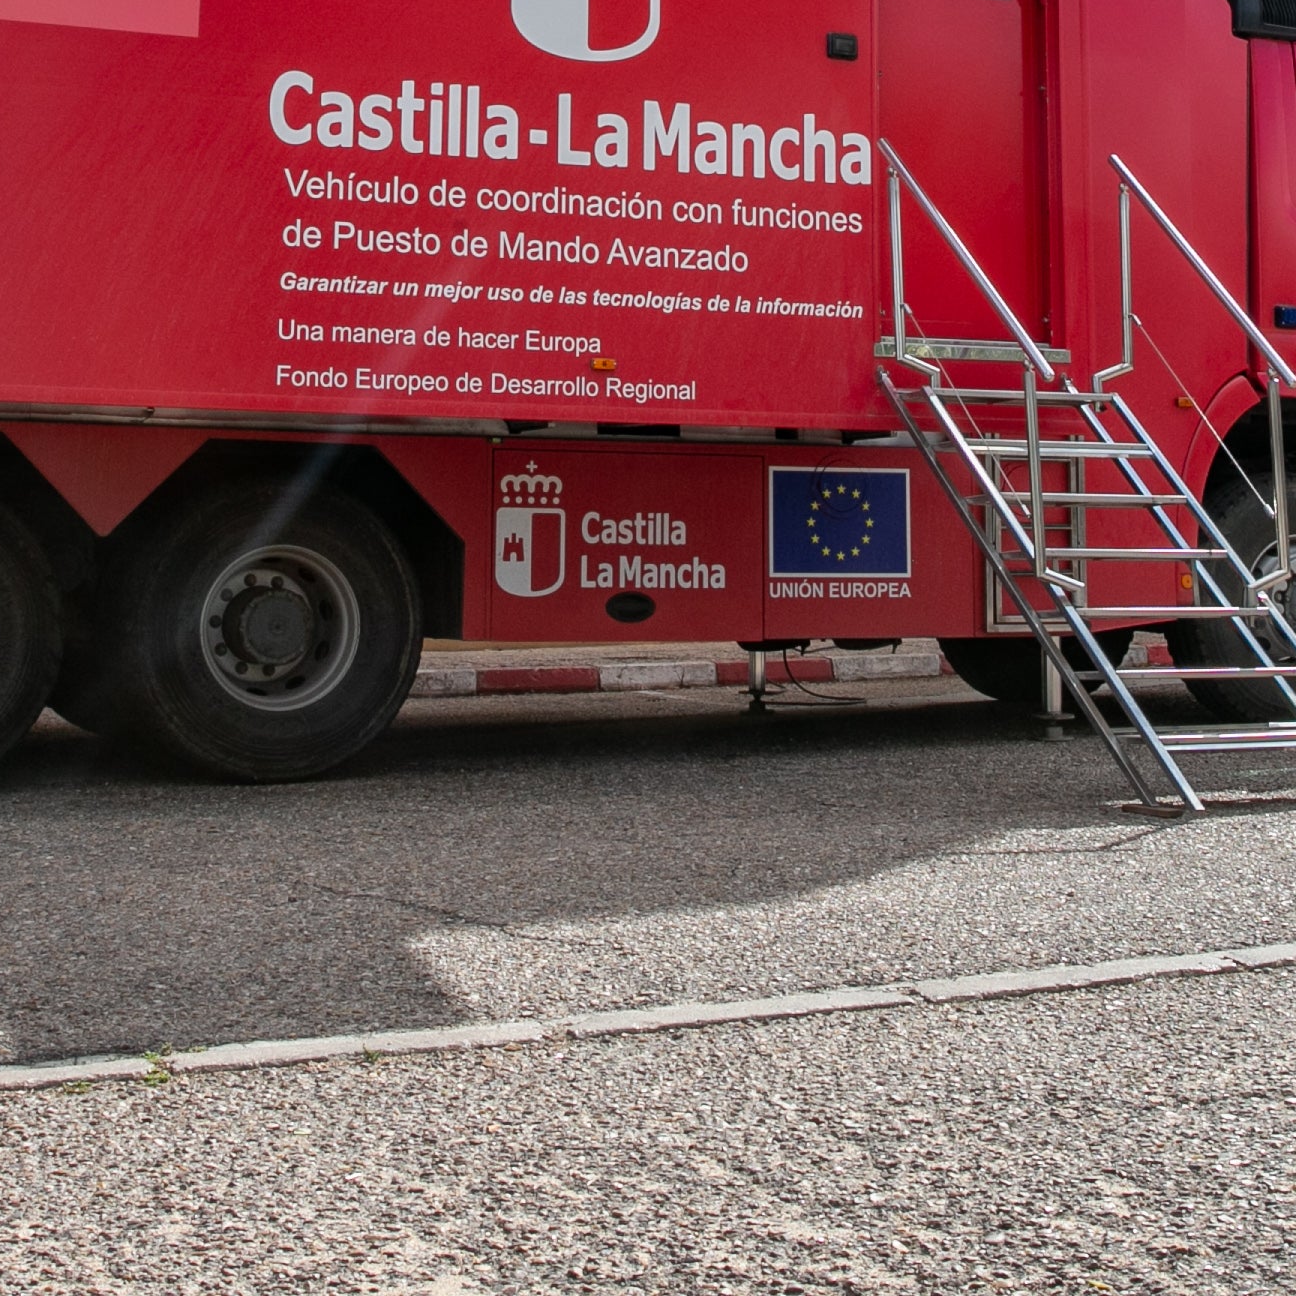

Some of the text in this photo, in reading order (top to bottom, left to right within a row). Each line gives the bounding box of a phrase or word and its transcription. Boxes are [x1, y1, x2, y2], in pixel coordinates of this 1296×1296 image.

[643, 99, 872, 185] Mancha
[284, 168, 863, 234] Vehículo de coordinación con funciones
[282, 219, 749, 273] de Puesto de Mando Avanzado
[279, 271, 864, 319] Garantizar un mejor uso de las tecnologías de la información
[278, 318, 601, 357] Una manera de hacer Europa
[276, 364, 696, 404] Fondo Europeo de Desarrollo Regional
[581, 511, 687, 546] Castilla
[580, 554, 726, 589] La Mancha
[769, 578, 912, 599] UNIÓN EUROPEA
